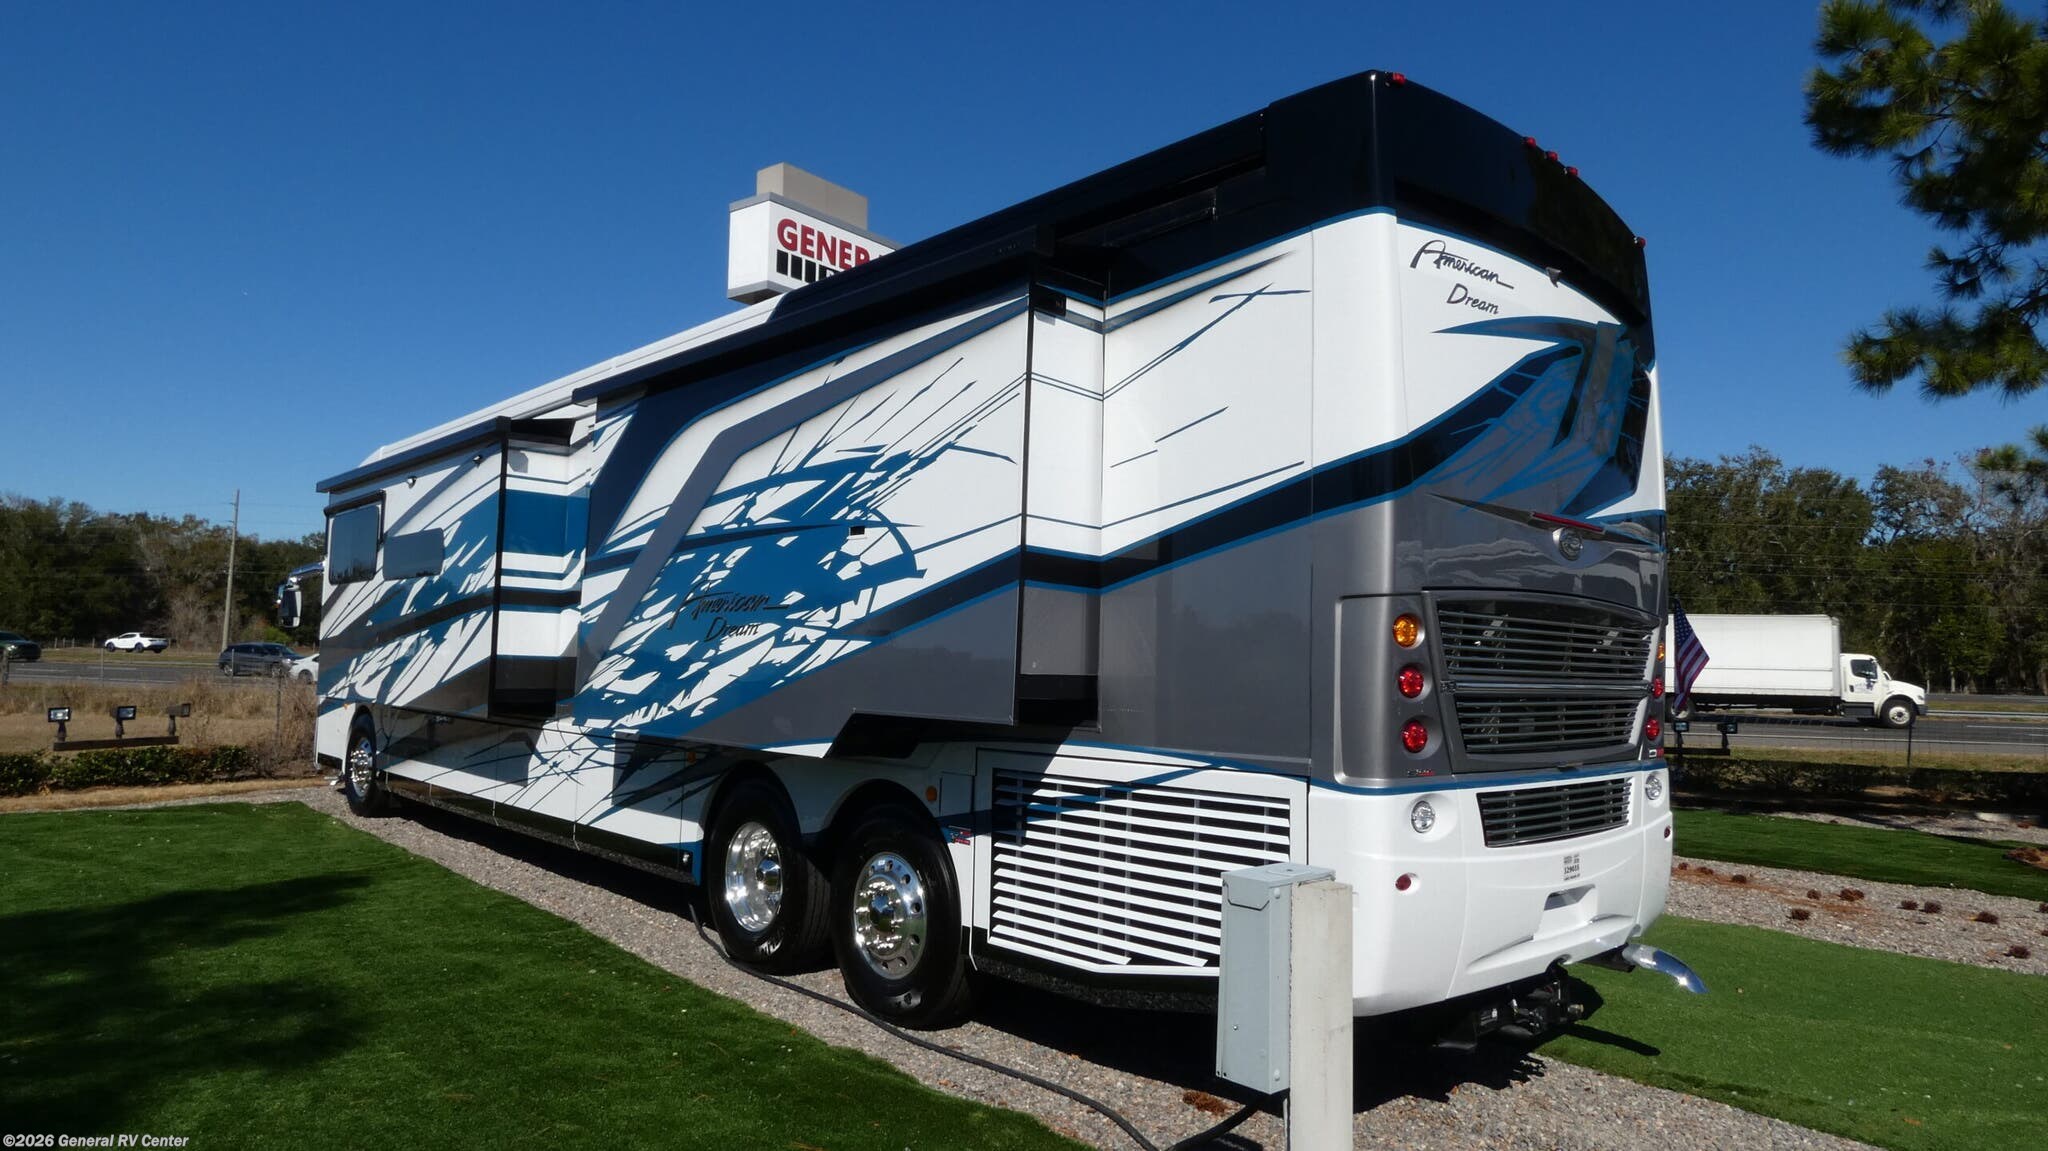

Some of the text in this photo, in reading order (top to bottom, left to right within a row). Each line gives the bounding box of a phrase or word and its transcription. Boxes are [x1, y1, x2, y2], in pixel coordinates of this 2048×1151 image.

[777, 218, 883, 270] GENER
[1410, 240, 1514, 289] American
[1446, 283, 1499, 315] Dream
[667, 580, 790, 630] American
[703, 616, 760, 643] Dream
